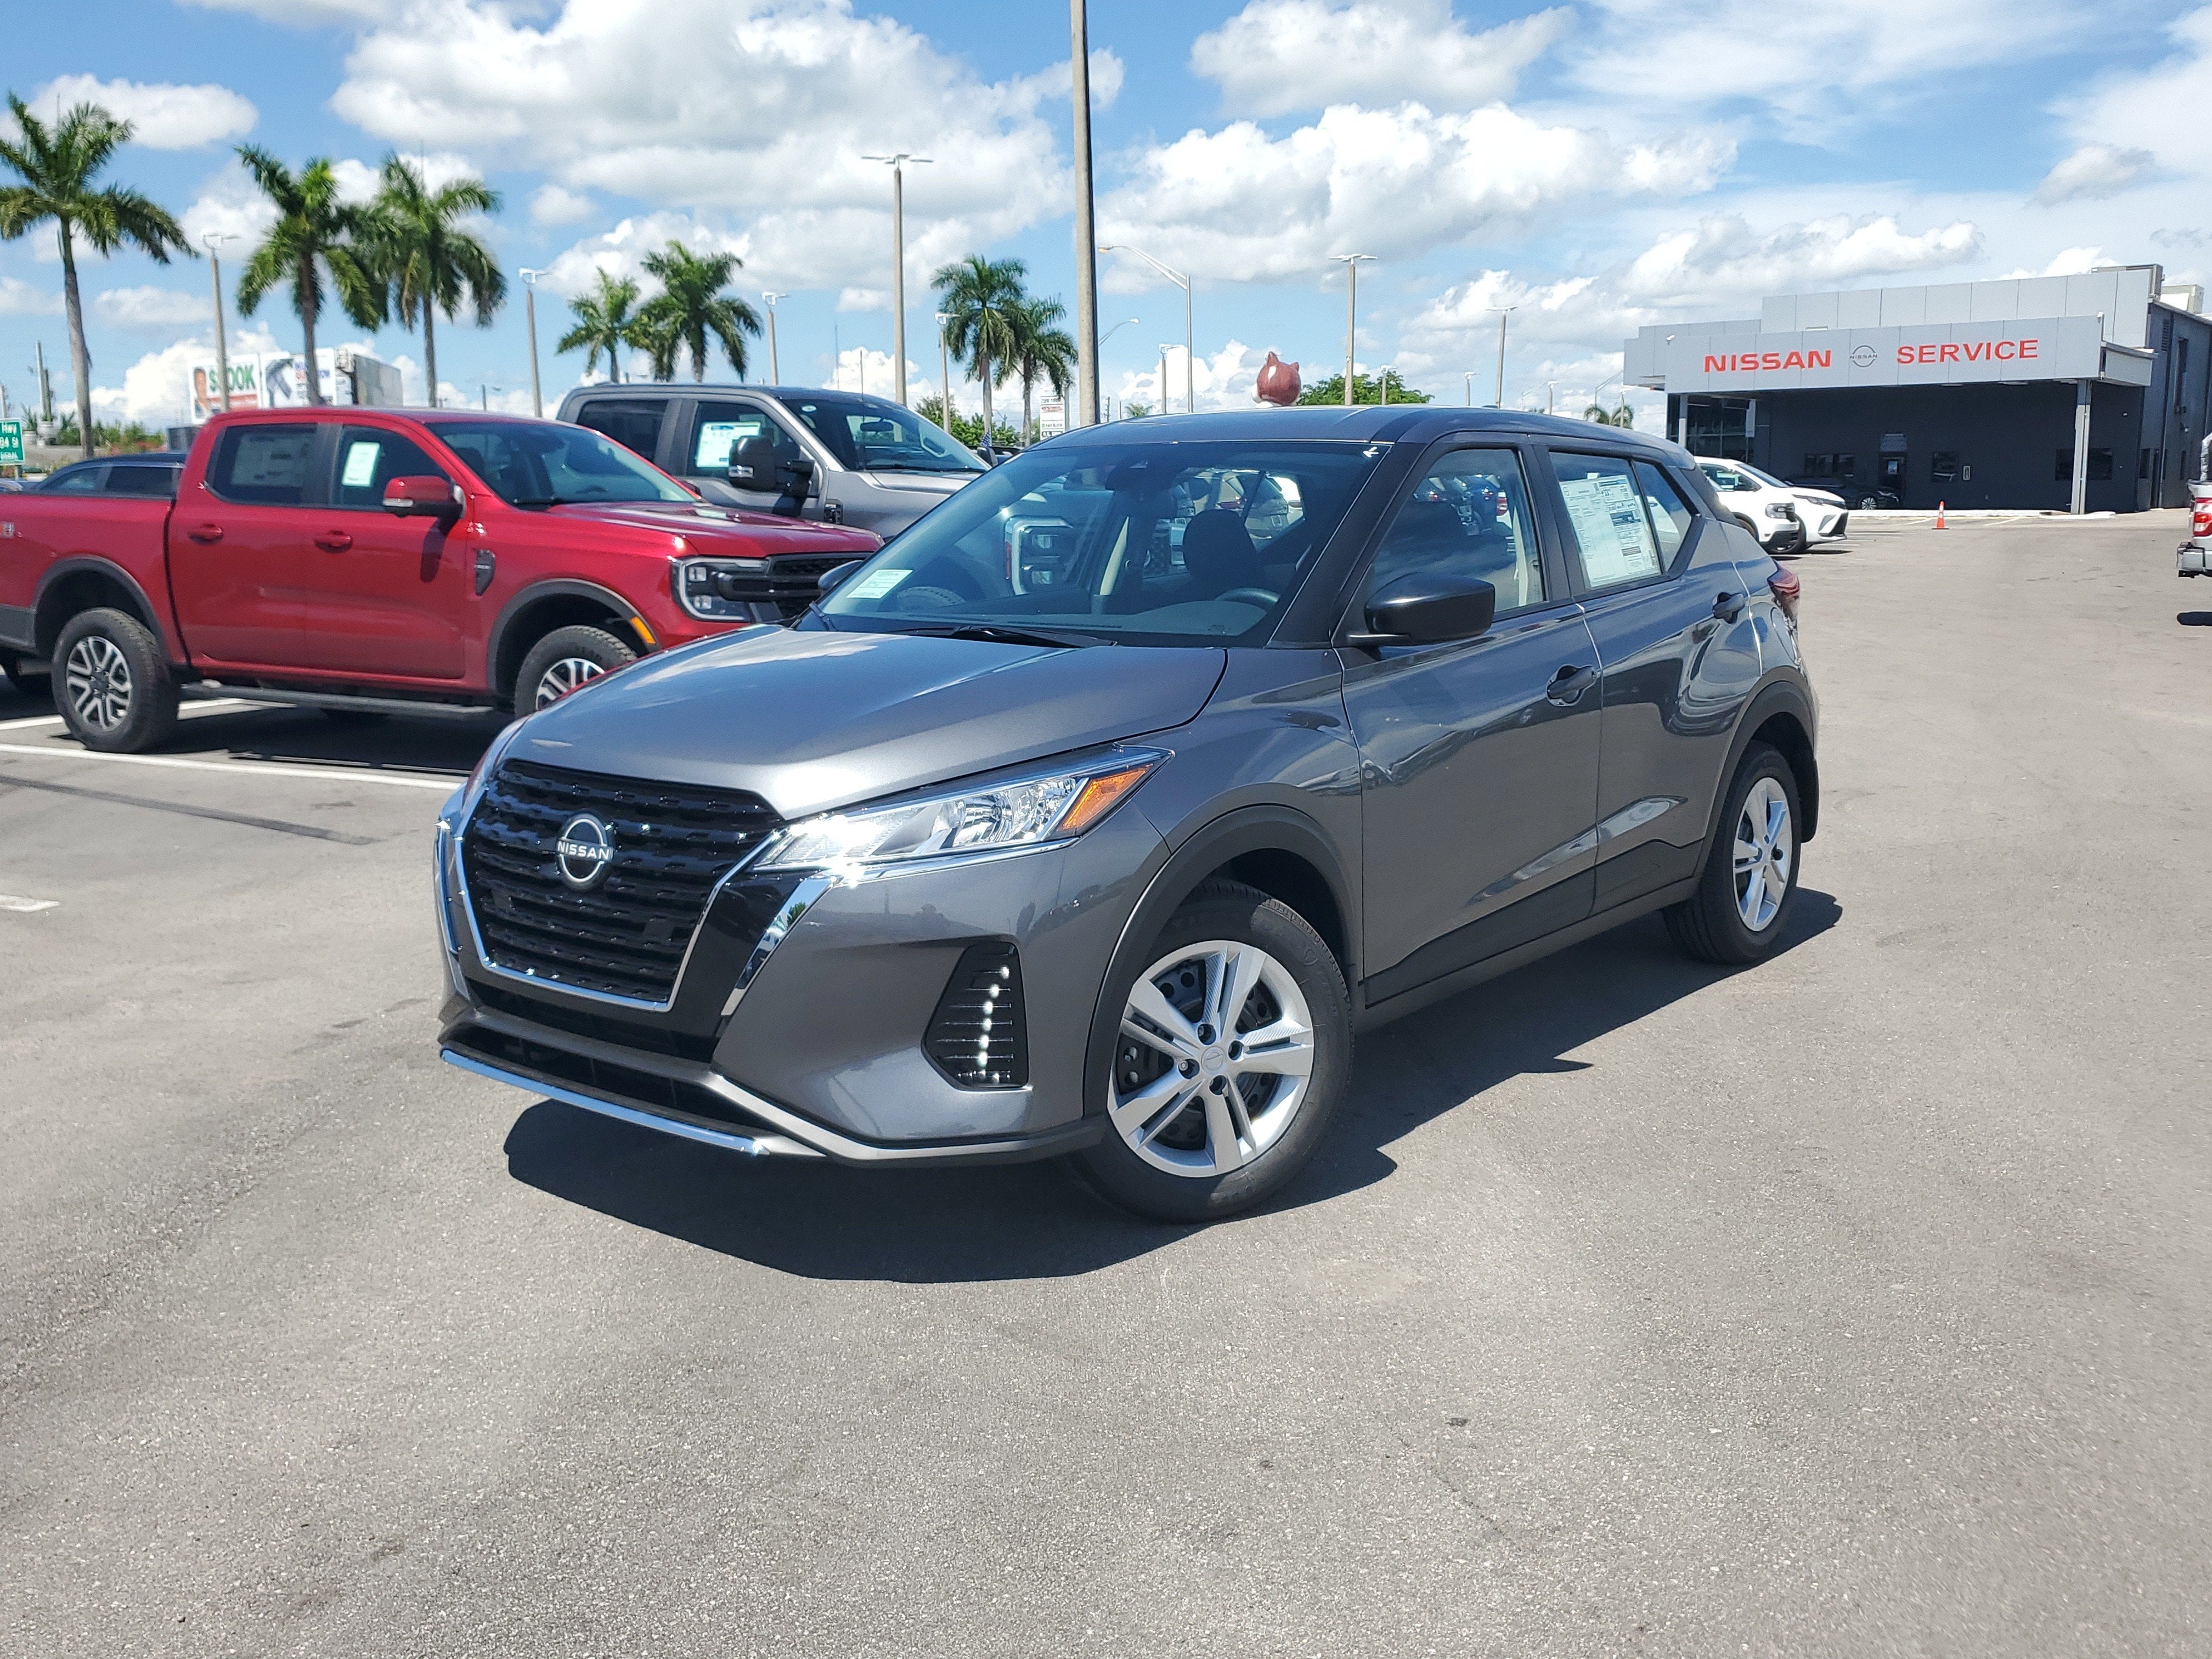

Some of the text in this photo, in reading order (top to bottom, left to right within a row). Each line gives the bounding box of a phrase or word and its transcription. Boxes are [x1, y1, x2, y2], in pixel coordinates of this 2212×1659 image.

[1704, 349, 1831, 373] NISSAN
[1897, 339, 2039, 364] SERVICE
[209, 364, 256, 392] SOOK
[2, 422, 17, 436] Hwy
[557, 840, 610, 860] NISSAN
